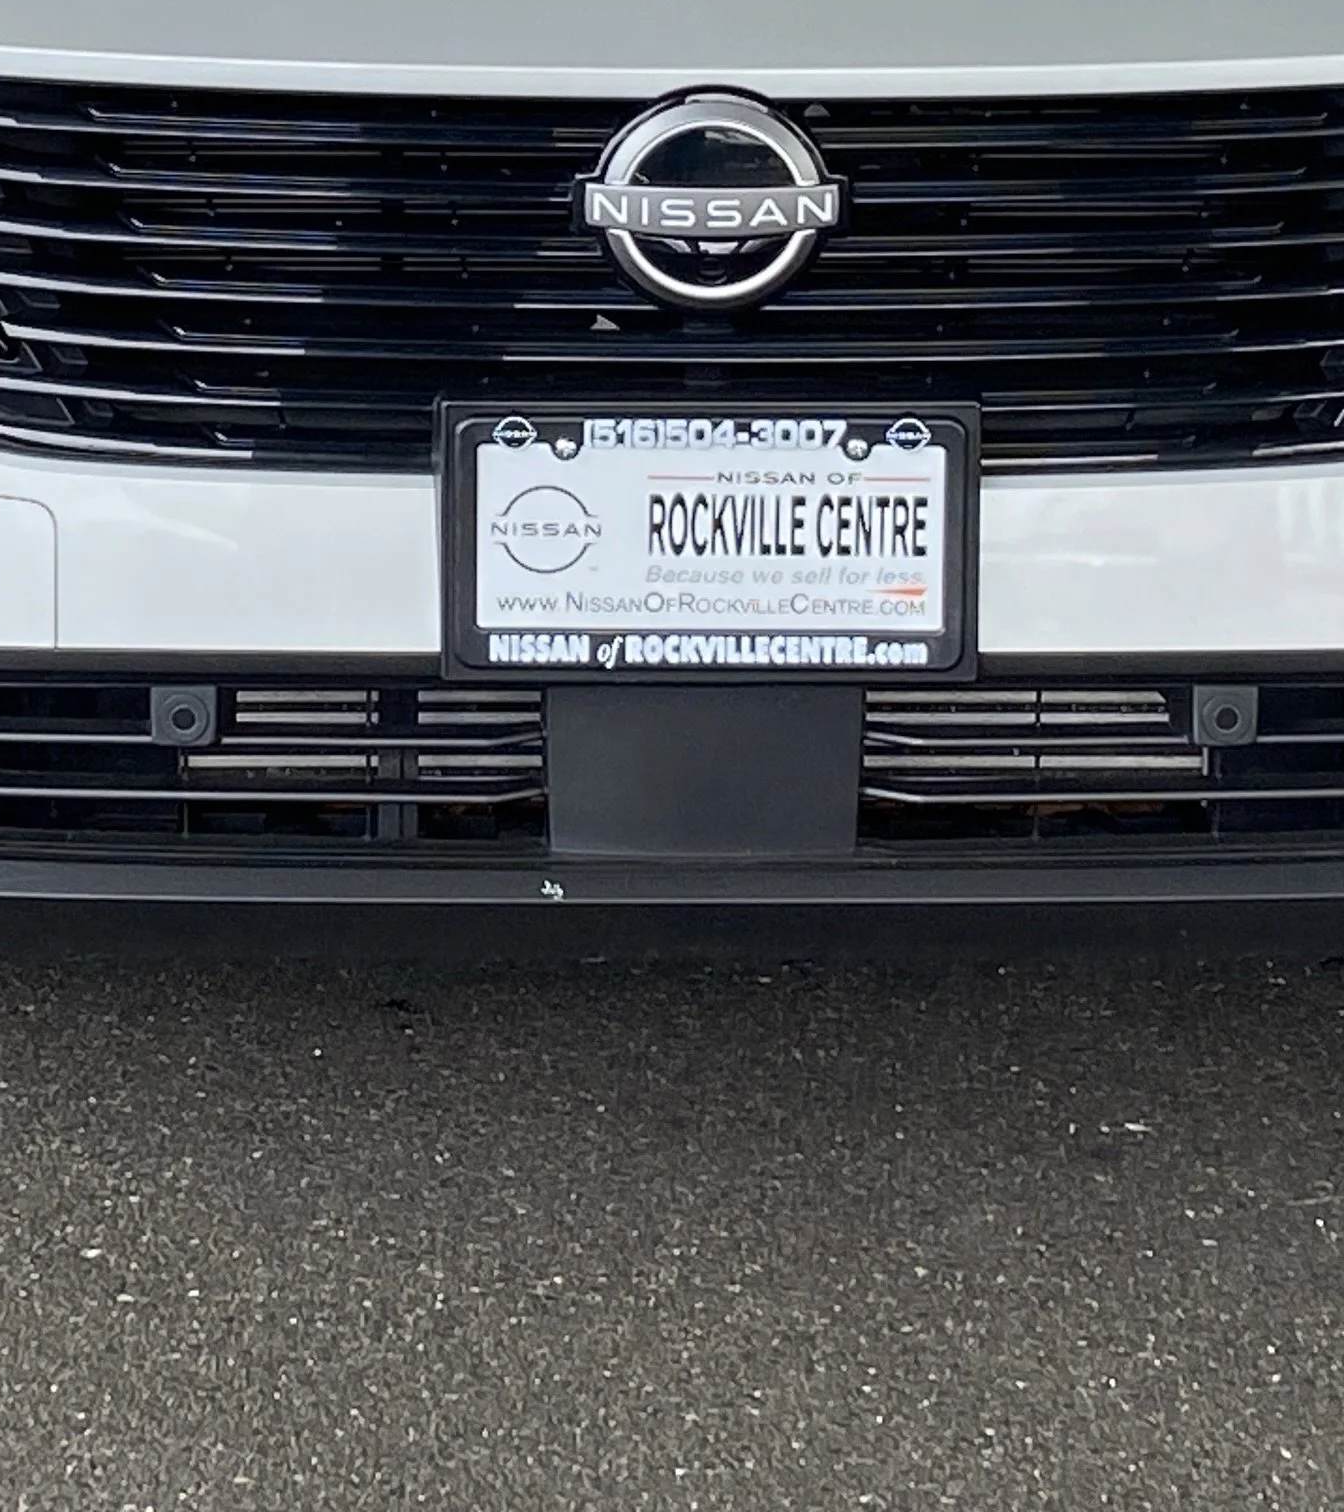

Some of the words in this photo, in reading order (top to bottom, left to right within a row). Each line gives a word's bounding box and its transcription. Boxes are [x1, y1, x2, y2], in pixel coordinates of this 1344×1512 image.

[592, 191, 833, 227] NISSAN
[717, 471, 815, 485] NISSAN
[827, 471, 862, 486] OF
[490, 521, 602, 543] NISSAN
[648, 493, 806, 557] ROCKVILLE
[816, 493, 928, 558] CENTRE
[646, 564, 743, 585] Because
[752, 569, 784, 586] we
[791, 565, 832, 586] sell
[839, 565, 869, 586] for
[489, 633, 591, 664] NISSAN
[597, 636, 624, 670] of
[624, 633, 929, 665] ROCKVILLECENTRE.com
